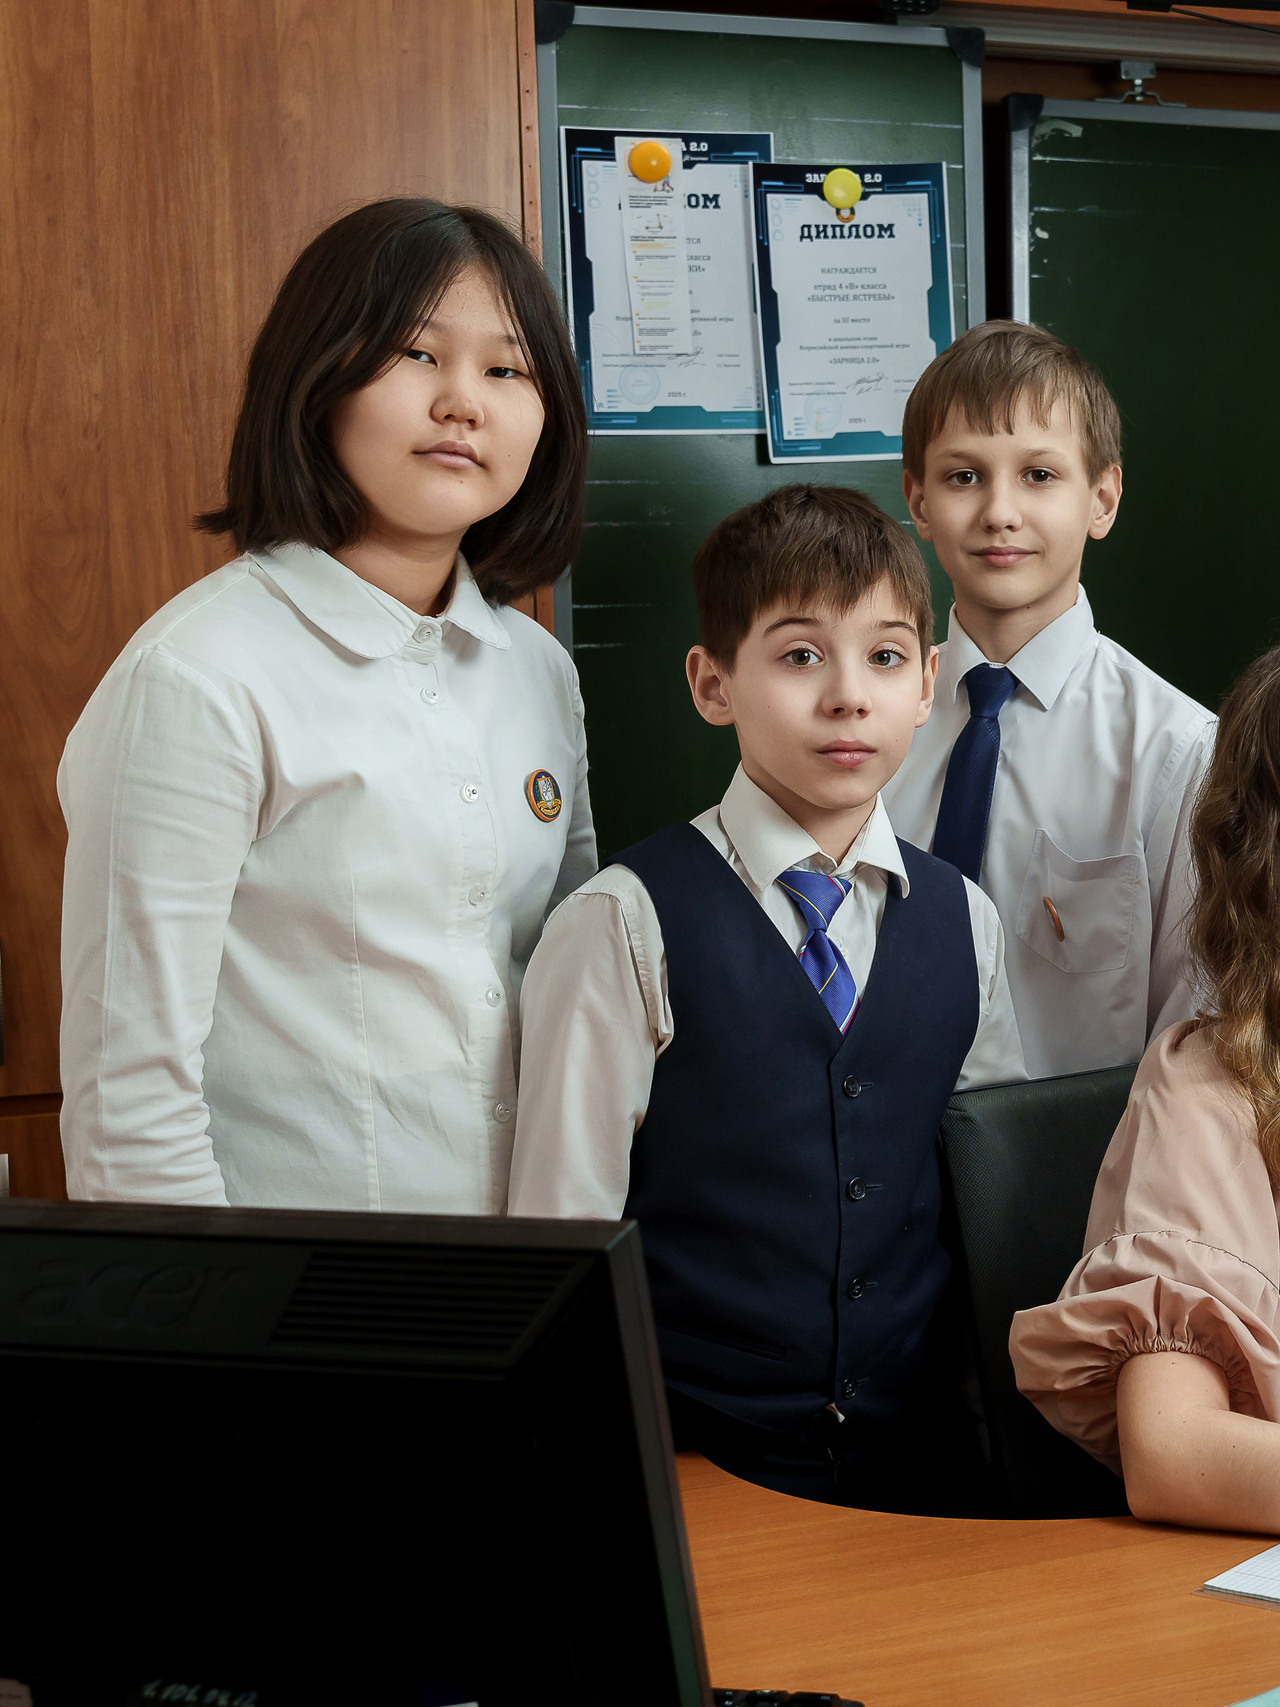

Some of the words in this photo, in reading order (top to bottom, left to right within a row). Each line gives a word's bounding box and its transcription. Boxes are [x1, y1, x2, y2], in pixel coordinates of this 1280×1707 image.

[689, 141, 708, 152] 2.0
[864, 173, 882, 183] 2.0
[800, 223, 895, 242] ДИПЛОМ
[813, 283, 837, 292] отряд
